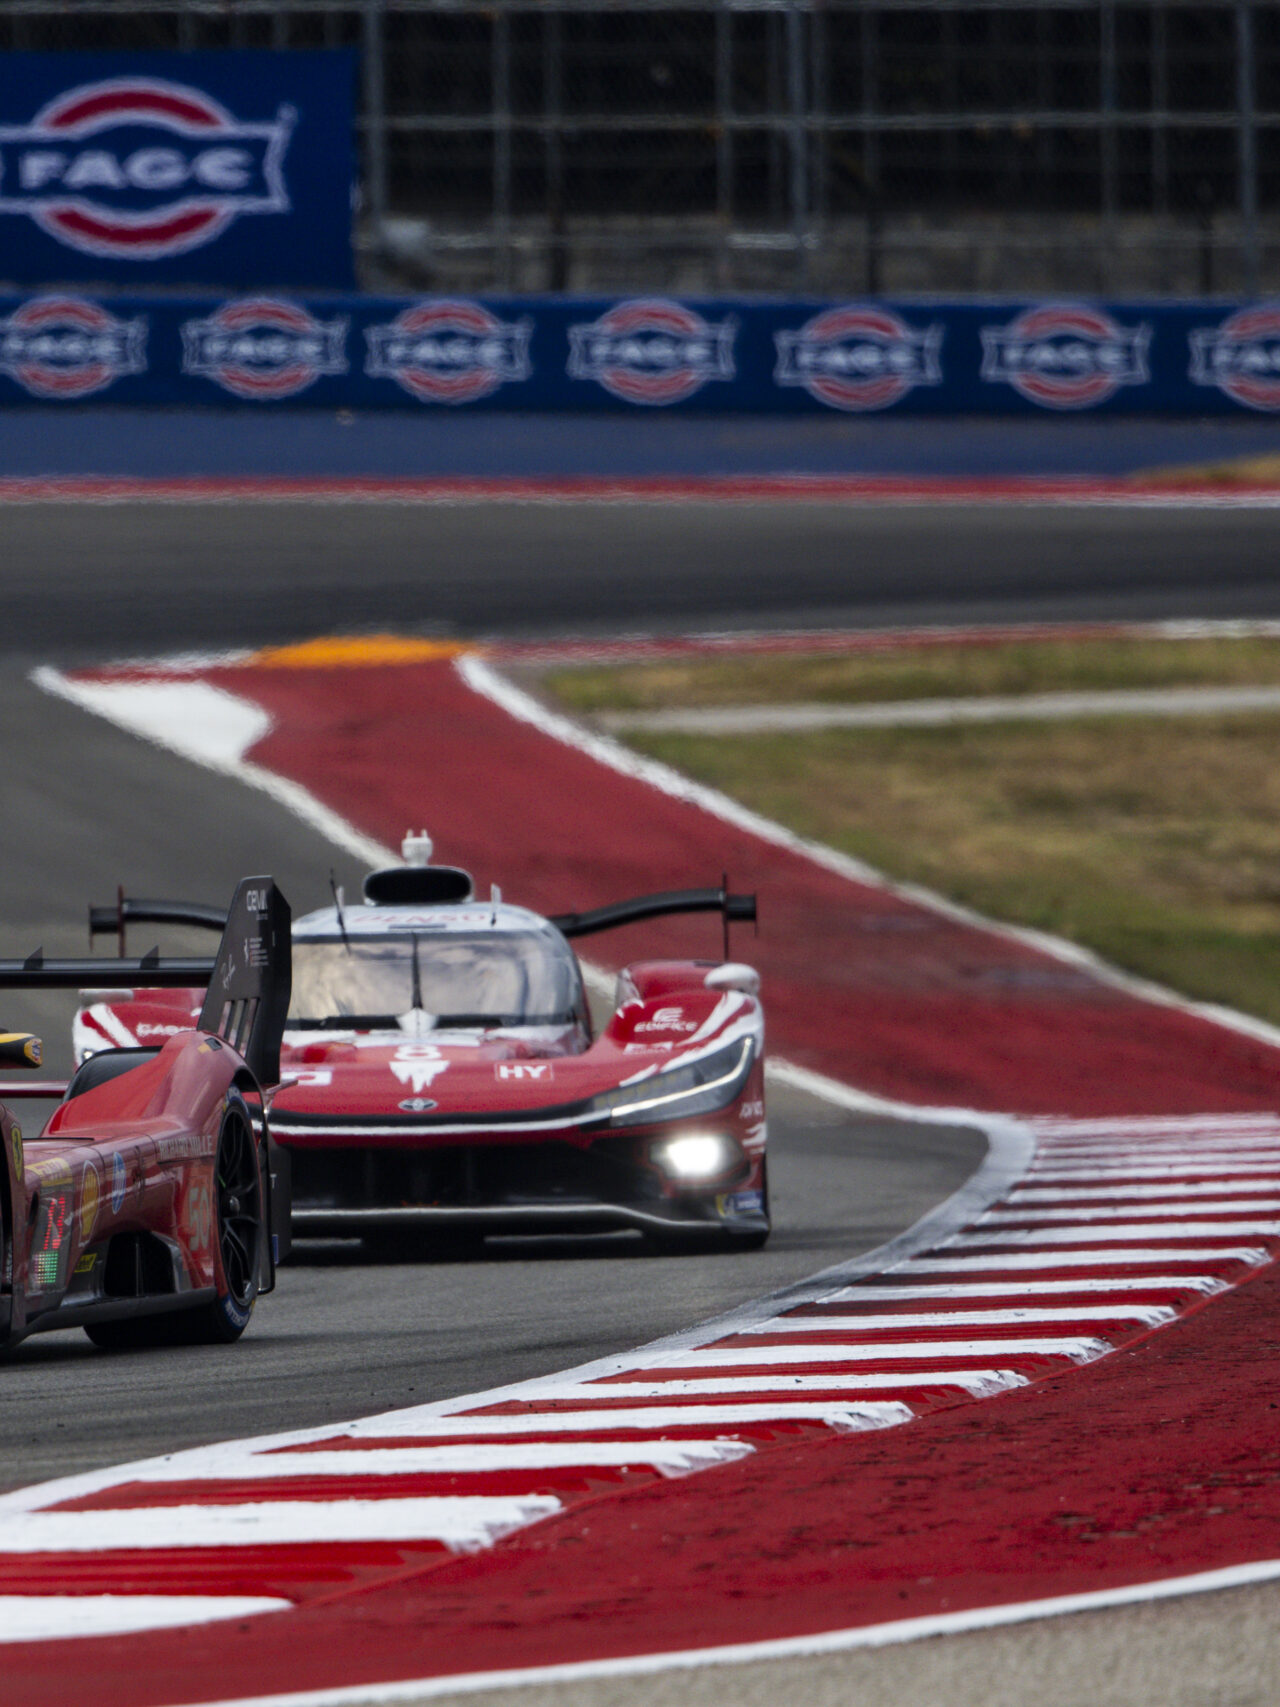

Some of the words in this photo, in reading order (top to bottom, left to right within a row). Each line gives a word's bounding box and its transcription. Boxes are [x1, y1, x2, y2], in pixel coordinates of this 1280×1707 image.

[18, 149, 254, 190] FAGE
[499, 1065, 547, 1079] HY
[188, 1186, 211, 1251] 50
